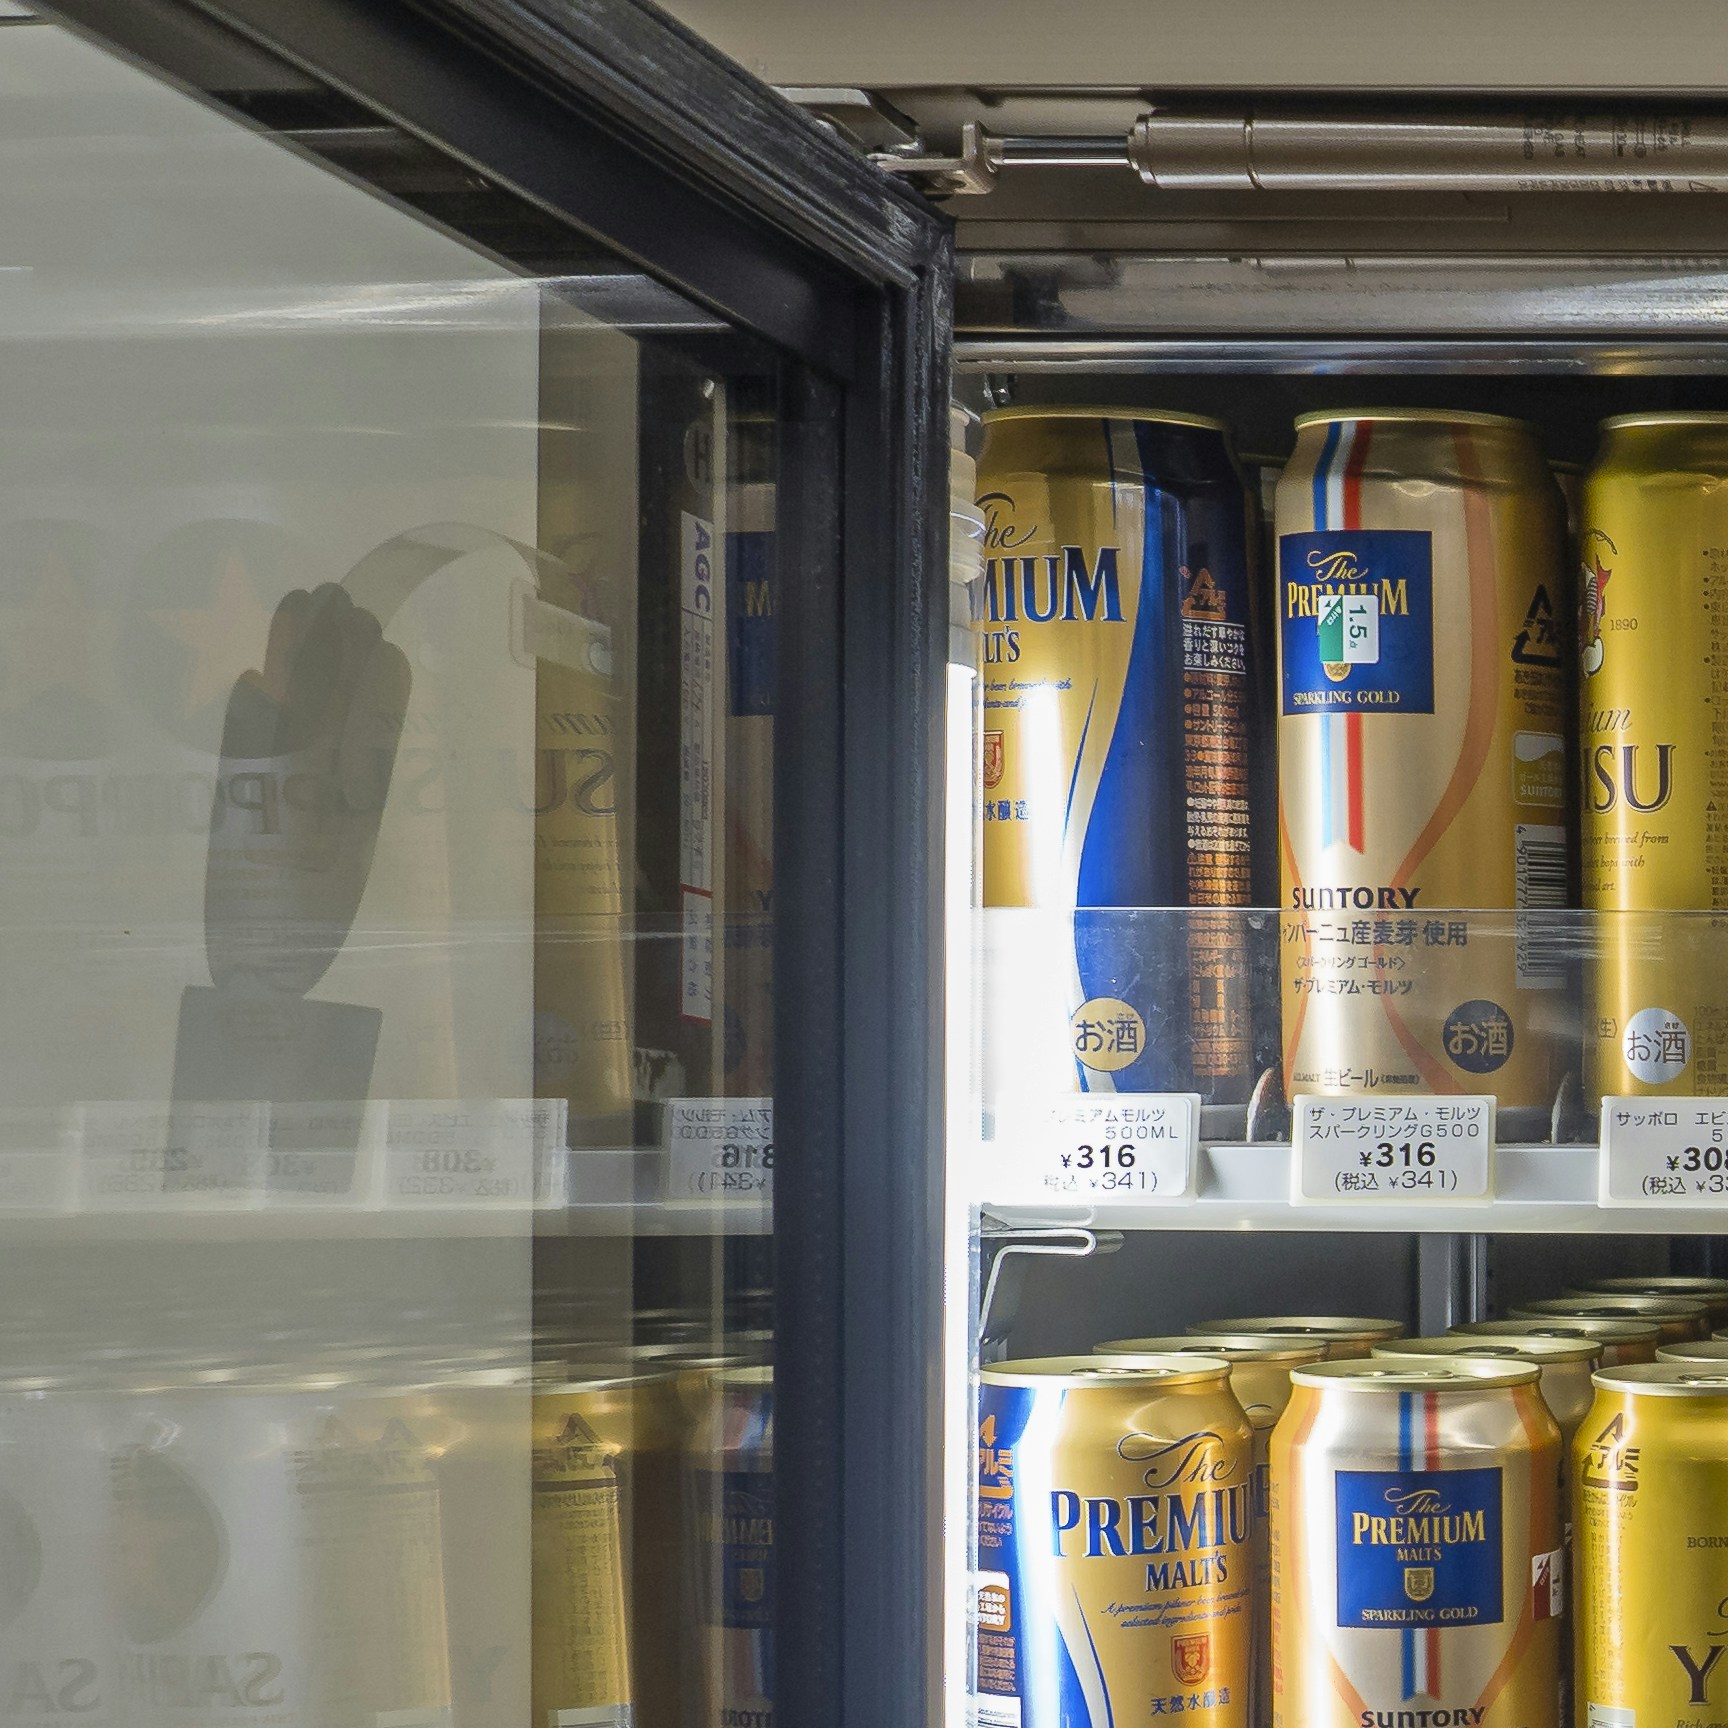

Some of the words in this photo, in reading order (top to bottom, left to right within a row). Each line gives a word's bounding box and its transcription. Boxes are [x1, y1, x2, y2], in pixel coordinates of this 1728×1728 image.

[1291, 887, 1421, 910] SUNTORY
[1074, 1017, 1140, 1054] お酒
[1448, 1020, 1509, 1055] お酒
[1626, 1028, 1688, 1066] お酒
[1615, 1111, 1678, 1127] サッポロ
[1060, 1143, 1137, 1170] ¥316
[1359, 1141, 1436, 1168] ¥316
[1334, 1171, 1380, 1192] (税込
[1388, 1169, 1458, 1192] ¥341)
[1352, 1510, 1486, 1546] PREMIUM
[1144, 1556, 1230, 1594] MALT'S
[1361, 1604, 1430, 1622] SPARKLING
[1438, 1604, 1480, 1620] GOLD
[1150, 1688, 1232, 1718] 天然水醸造
[1361, 1706, 1485, 1728] SUNTORY
